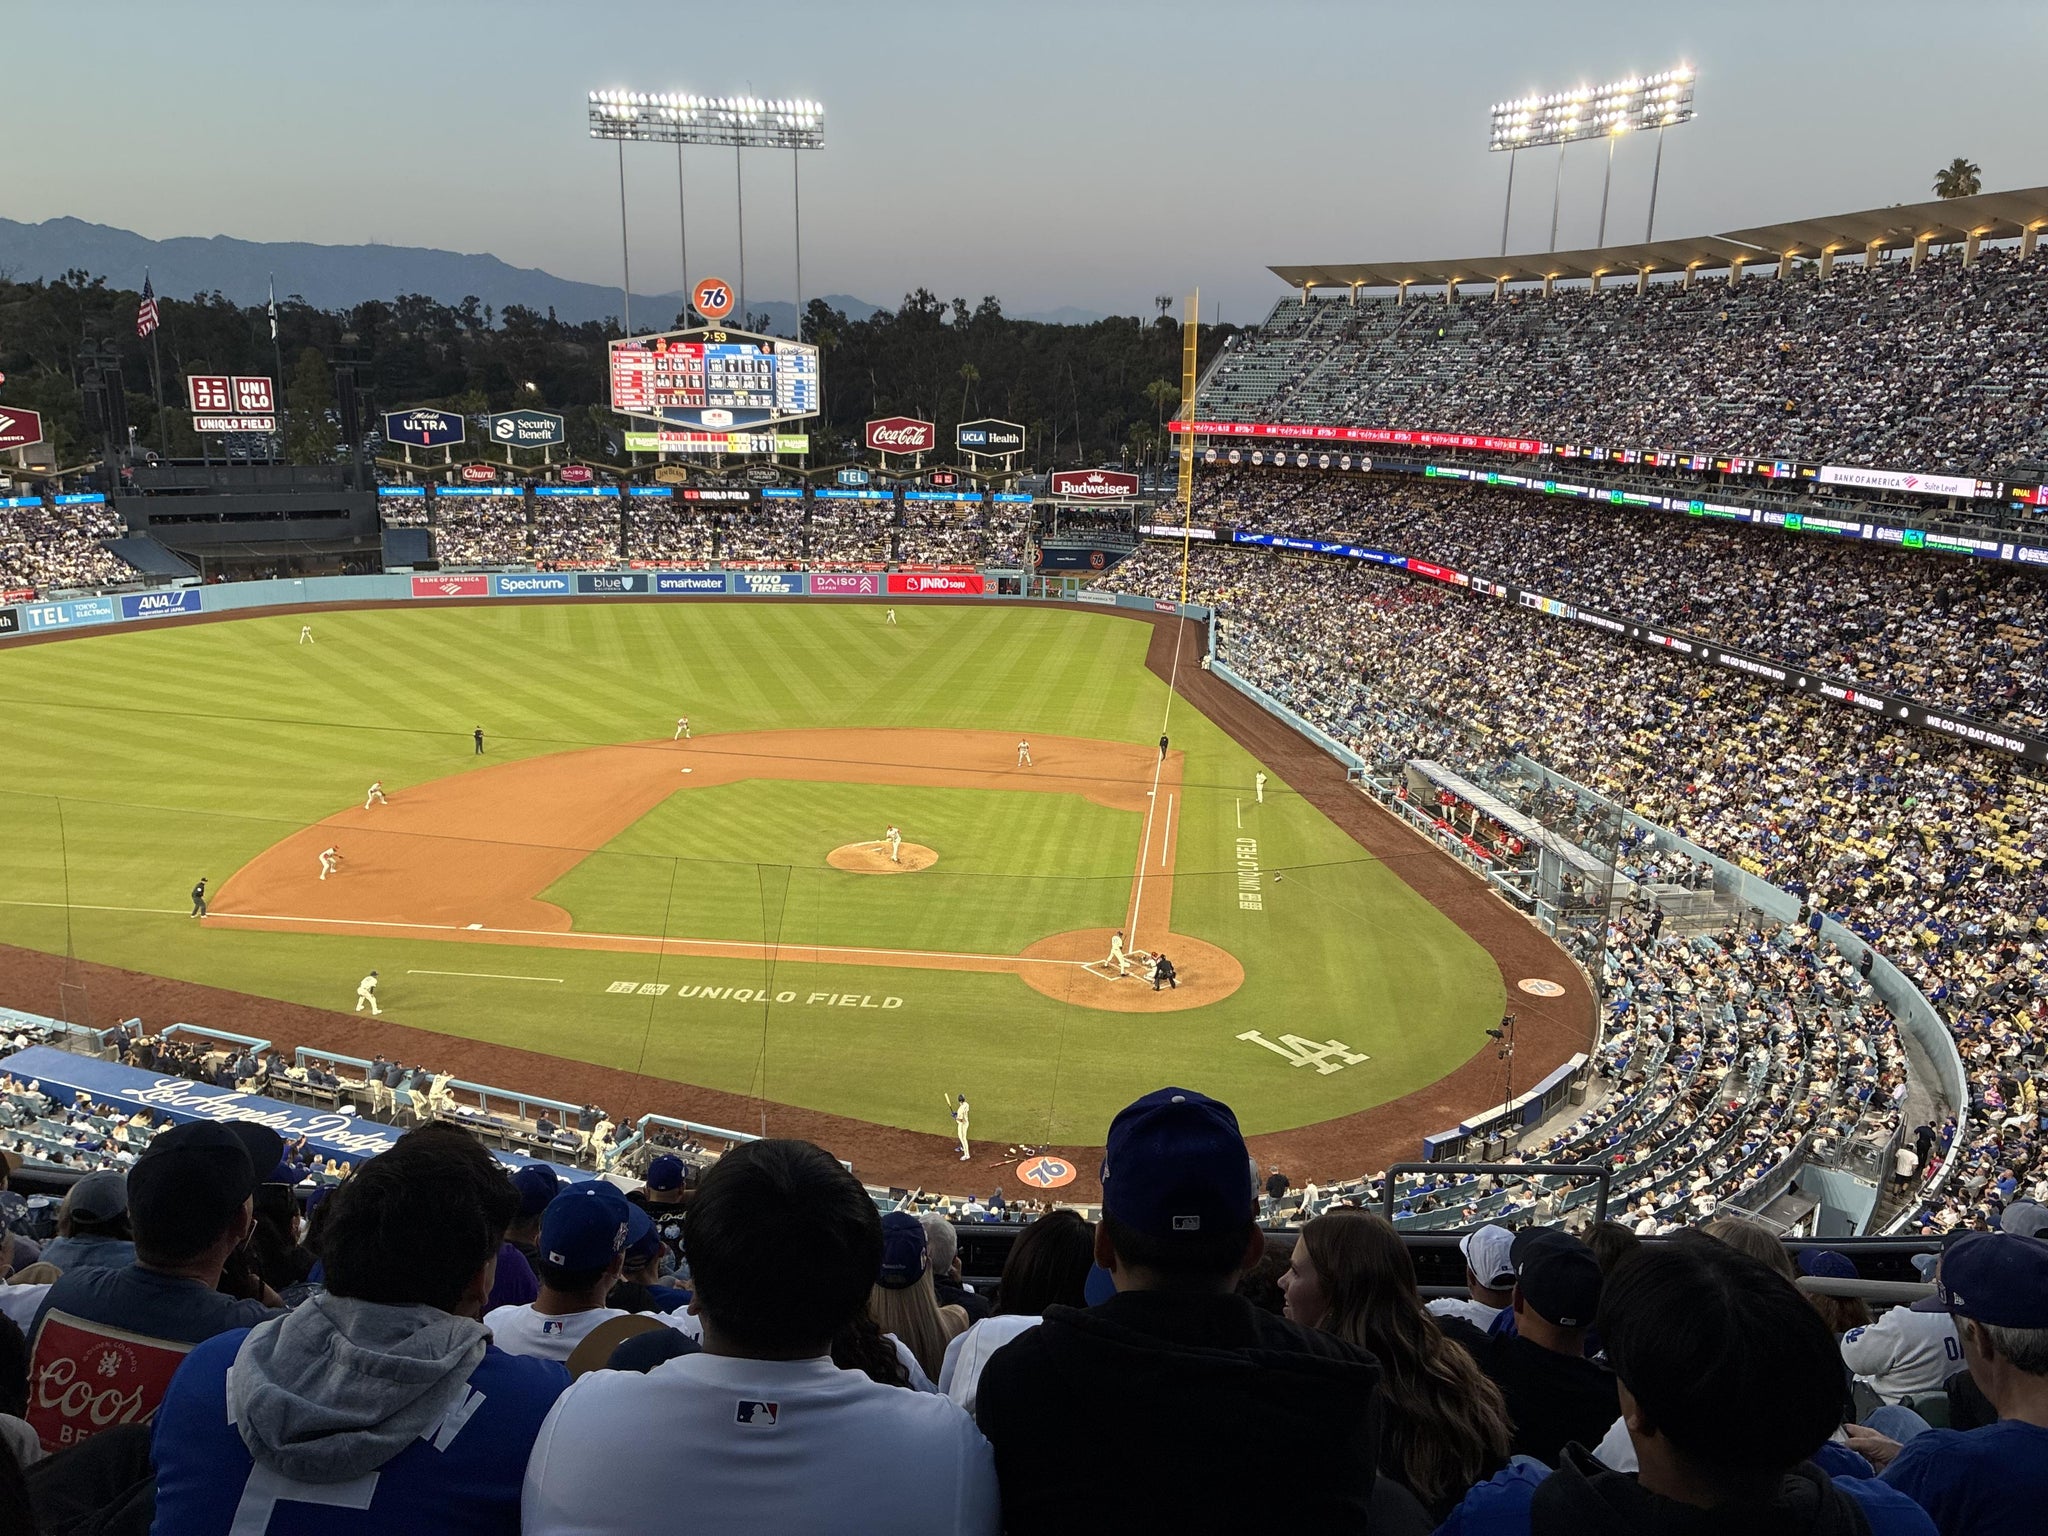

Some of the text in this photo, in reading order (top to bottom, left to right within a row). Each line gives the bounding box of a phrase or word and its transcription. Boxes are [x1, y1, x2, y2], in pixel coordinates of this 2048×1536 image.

[700, 287, 727, 309] 76
[703, 331, 727, 342] 7:59
[240, 382, 266, 395] UNI
[241, 395, 269, 409] QLO
[200, 419, 271, 431] UNIQLO FIELD
[403, 420, 448, 431] ULTRA
[517, 419, 557, 431] Security
[519, 429, 553, 440] Benefit
[873, 425, 928, 446] Coca-Cola
[962, 431, 1020, 444] UCLA Health
[463, 469, 495, 479] Churu
[841, 472, 865, 483] TEL
[1802, 468, 1817, 476] FINAL
[1834, 474, 1958, 493] BANK OF AMERICA Suite Level
[699, 490, 727, 500] UNIQLO
[728, 491, 750, 500] FIELD
[2012, 488, 2031, 498] FINAL
[1091, 554, 1104, 566] 76
[500, 578, 558, 593] Spectrum
[594, 577, 621, 587] blue
[660, 578, 723, 589] smartwater
[743, 575, 782, 584] TOYO
[817, 577, 857, 586] DAISO
[920, 577, 949, 590] JINRO
[985, 581, 996, 591] 76
[750, 583, 791, 593] TIRES
[74, 601, 98, 611] TOKYO
[138, 594, 169, 610] ANA
[29, 606, 70, 627] TEL
[76, 607, 111, 618] ELECTRON
[1720, 653, 1786, 681] WE GO TO BAT FOR YOU
[1846, 689, 1854, 702] &
[1926, 714, 2026, 753] WE GO TO BAT FOR YOU
[1236, 837, 1258, 860] FIELD
[1237, 861, 1264, 892] UNIQLO
[1528, 981, 1557, 994] 76
[677, 984, 904, 1009] UNIQLO FIELD
[1235, 1029, 1371, 1076] LA
[121, 1078, 196, 1107] Los
[1024, 1157, 1067, 1187] 76
[38, 1357, 161, 1426] Coor
